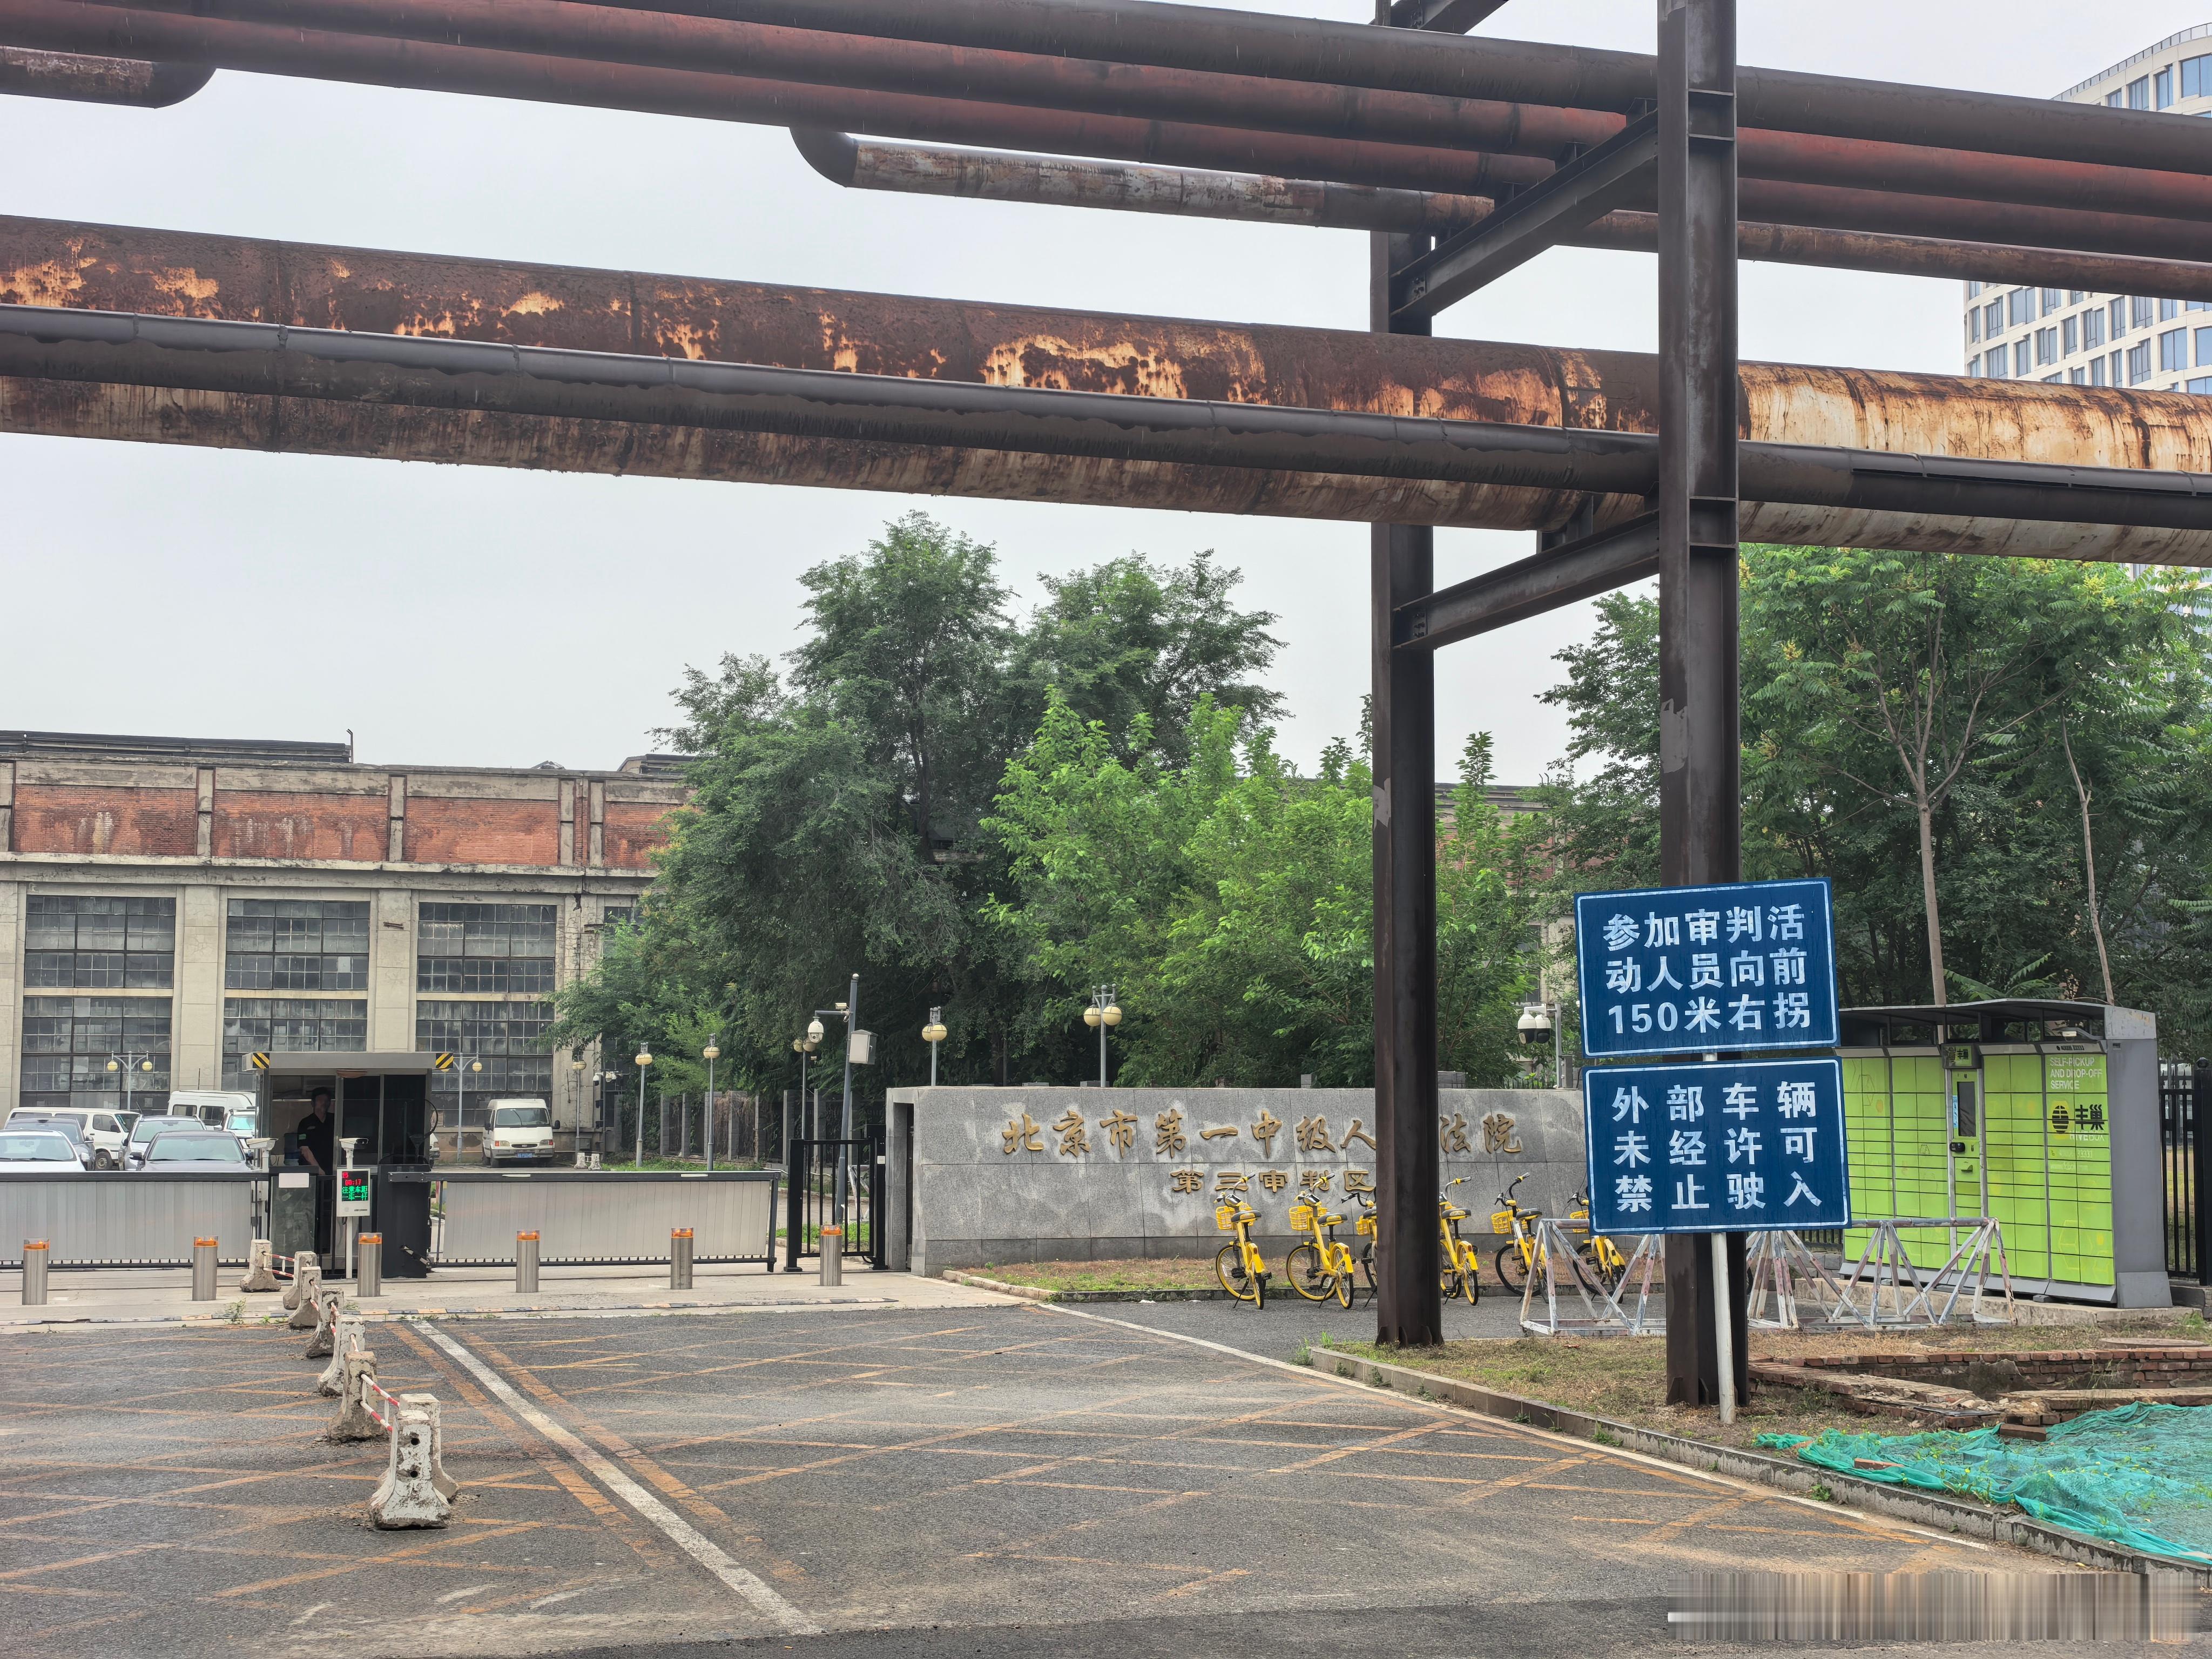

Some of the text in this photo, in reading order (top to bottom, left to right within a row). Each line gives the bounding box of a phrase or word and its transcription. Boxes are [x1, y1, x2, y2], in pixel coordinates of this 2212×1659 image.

[1602, 903, 1805, 952] 参加审判活
[1605, 947, 1808, 994] 动人员向前
[1608, 992, 1810, 1034] 150米右拐
[2049, 1057, 2095, 1067] SELF-PICKUP
[2050, 1069, 2065, 1078] AND
[1611, 1081, 1816, 1124] 外部车辆
[2051, 1080, 2080, 1090] SERVICE
[1002, 1108, 1522, 1159] 北京市第一中级人法院
[2075, 1104, 2105, 1130] 丰巢
[1613, 1127, 1818, 1168] 未经许可
[1170, 1169, 1375, 1194] 第三审判区
[1615, 1171, 1823, 1213] 禁止驶入
